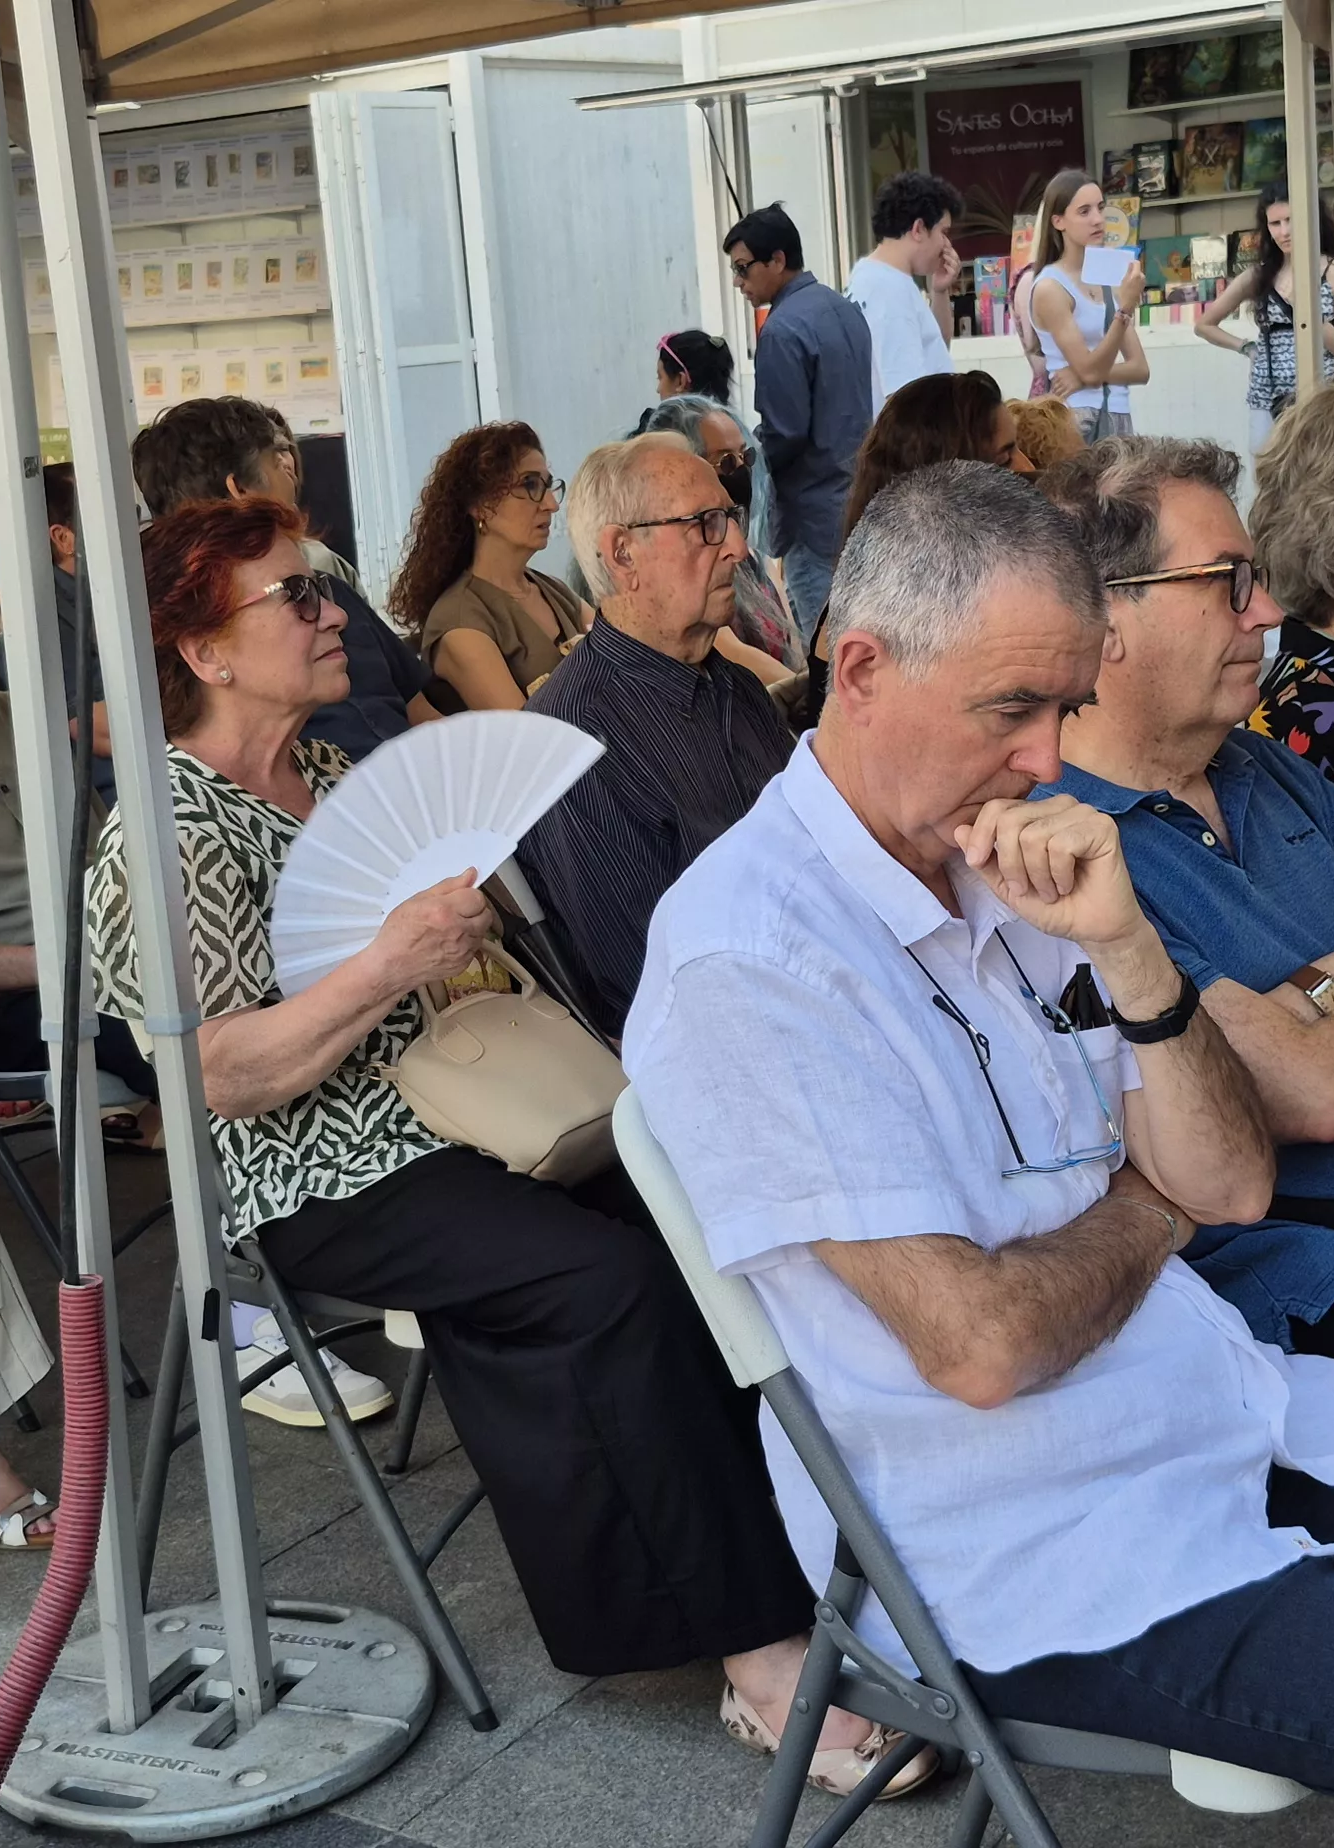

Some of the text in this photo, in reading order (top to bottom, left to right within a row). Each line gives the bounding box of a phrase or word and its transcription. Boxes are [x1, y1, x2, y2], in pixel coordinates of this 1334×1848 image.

[936, 102, 1074, 135] SANTOS OCHOA
[963, 145, 995, 156] espacio
[996, 142, 1007, 152] de
[1008, 140, 1038, 151] cultura
[1046, 139, 1064, 148] ocio
